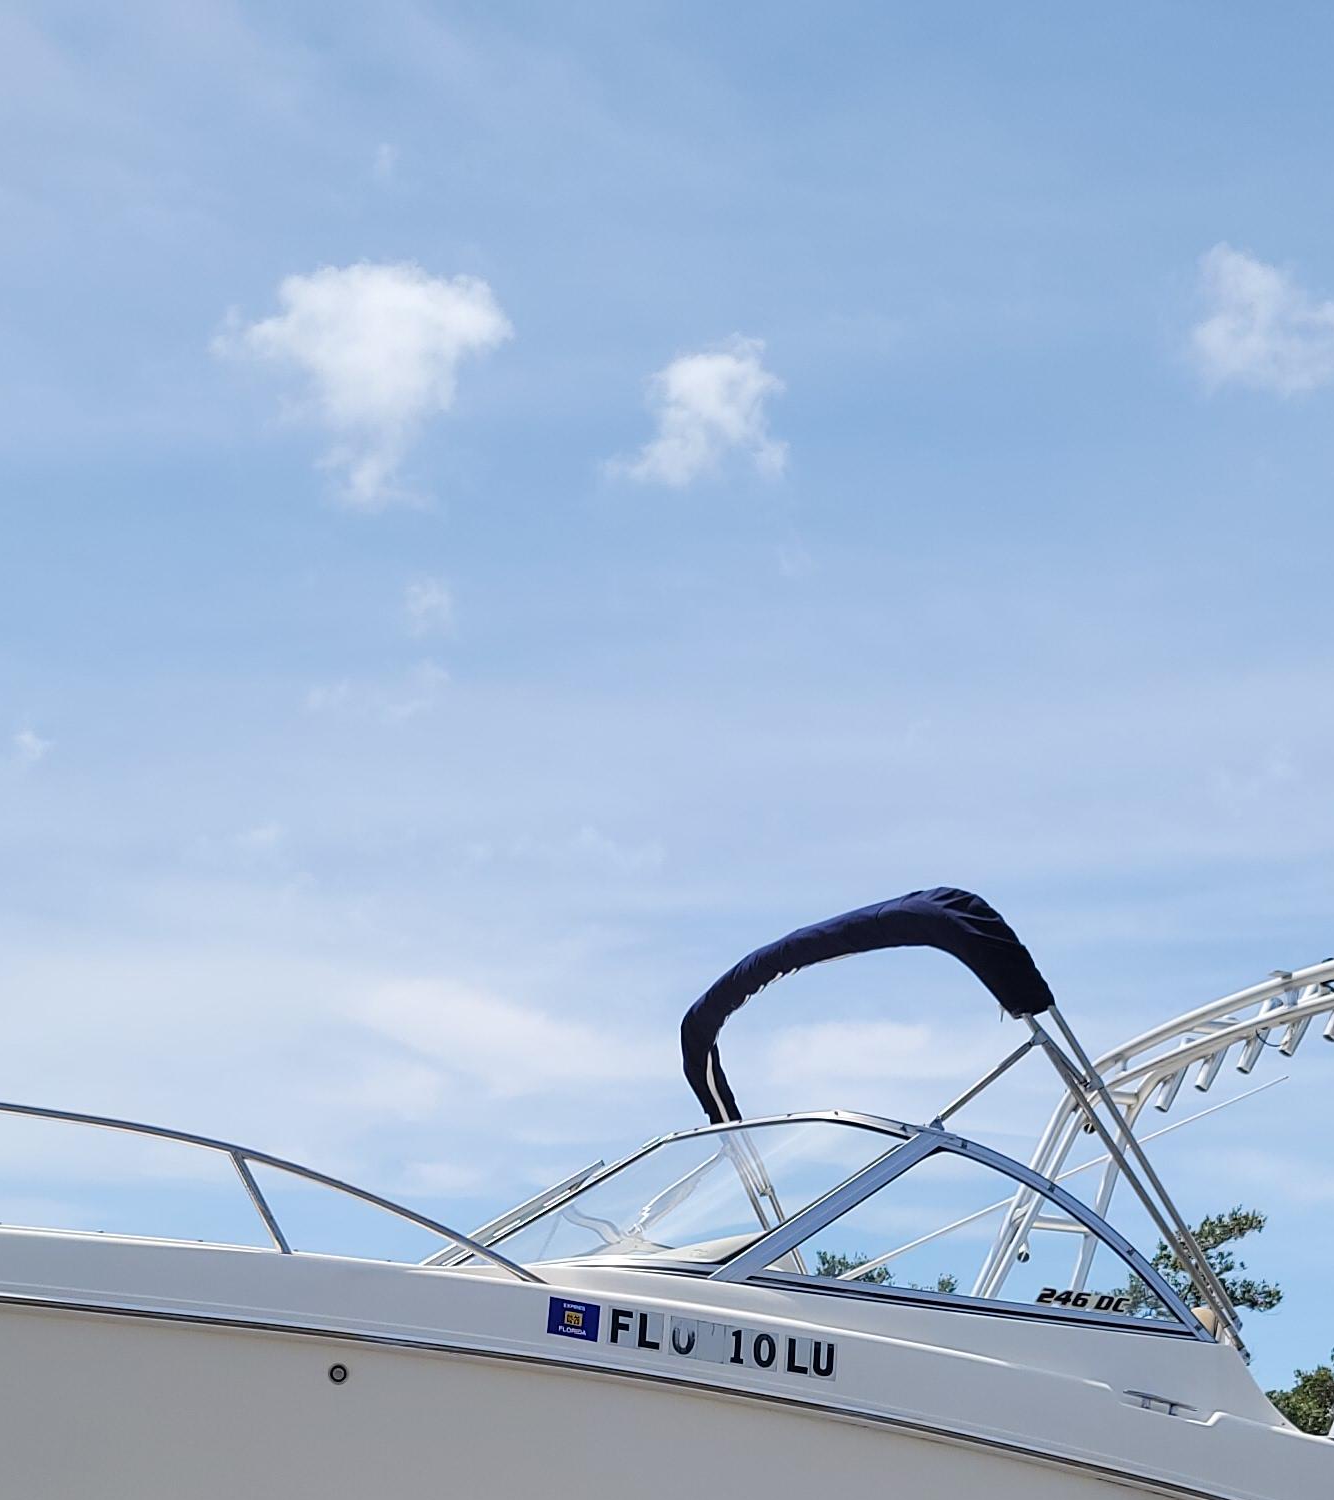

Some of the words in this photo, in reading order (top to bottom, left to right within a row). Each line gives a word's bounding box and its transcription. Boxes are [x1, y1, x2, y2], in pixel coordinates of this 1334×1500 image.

[1035, 1287, 1091, 1308] 246
[1094, 1295, 1130, 1313] DC
[558, 1325, 587, 1336] FLORIDA
[609, 1307, 660, 1351] FL
[786, 1339, 835, 1378] LU
